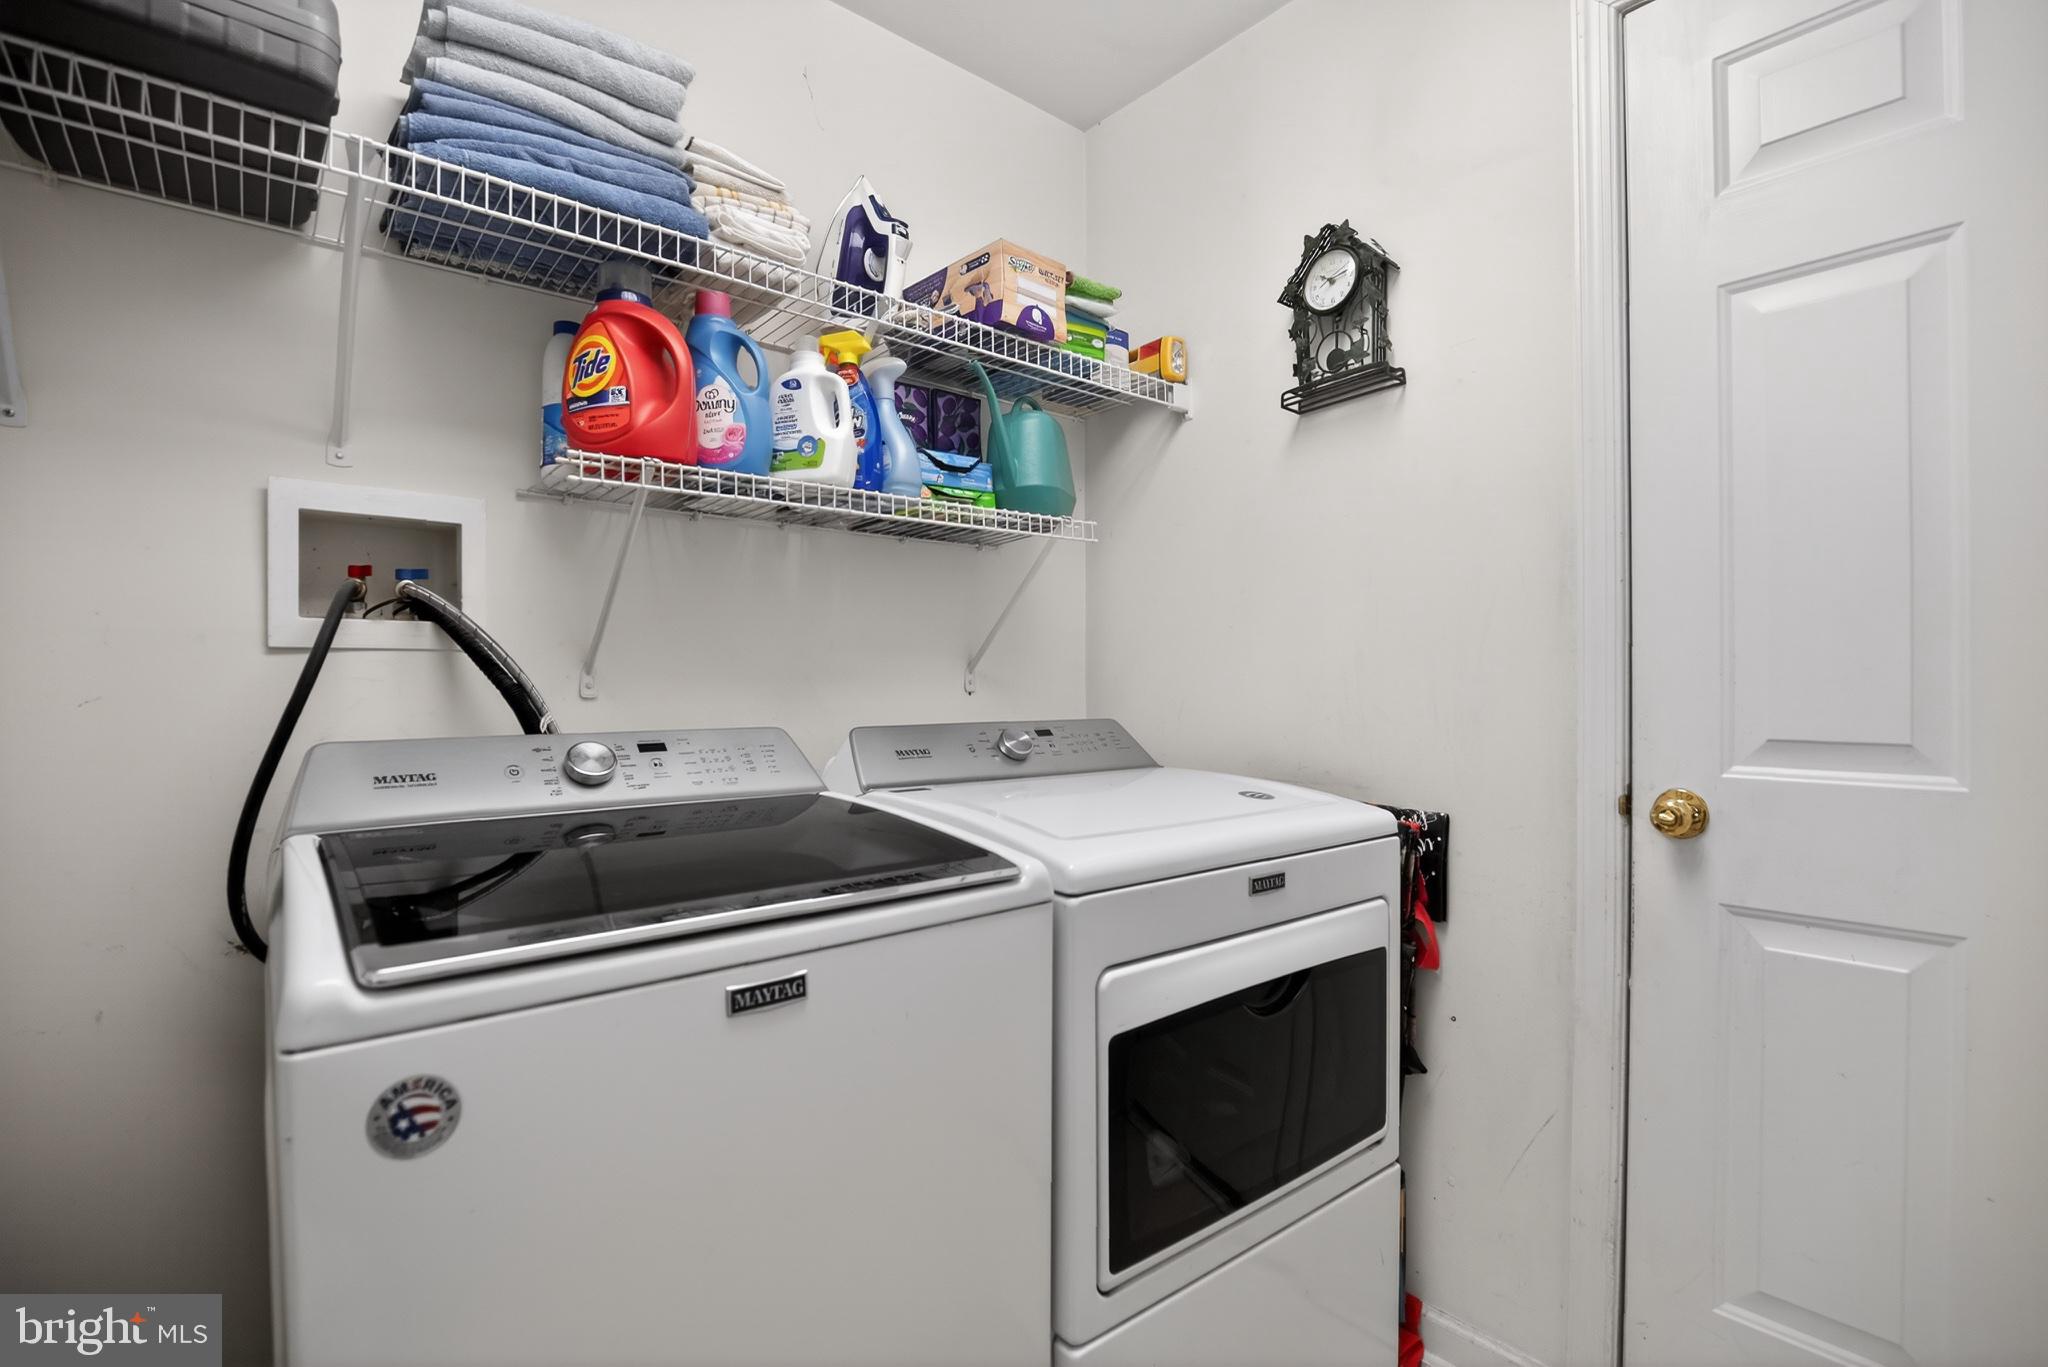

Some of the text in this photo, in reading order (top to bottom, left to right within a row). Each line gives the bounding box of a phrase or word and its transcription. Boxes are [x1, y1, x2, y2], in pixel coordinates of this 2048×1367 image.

[571, 348, 611, 389] Tide
[373, 772, 437, 785] MAYTAG
[733, 979, 805, 1010] MAYTAG
